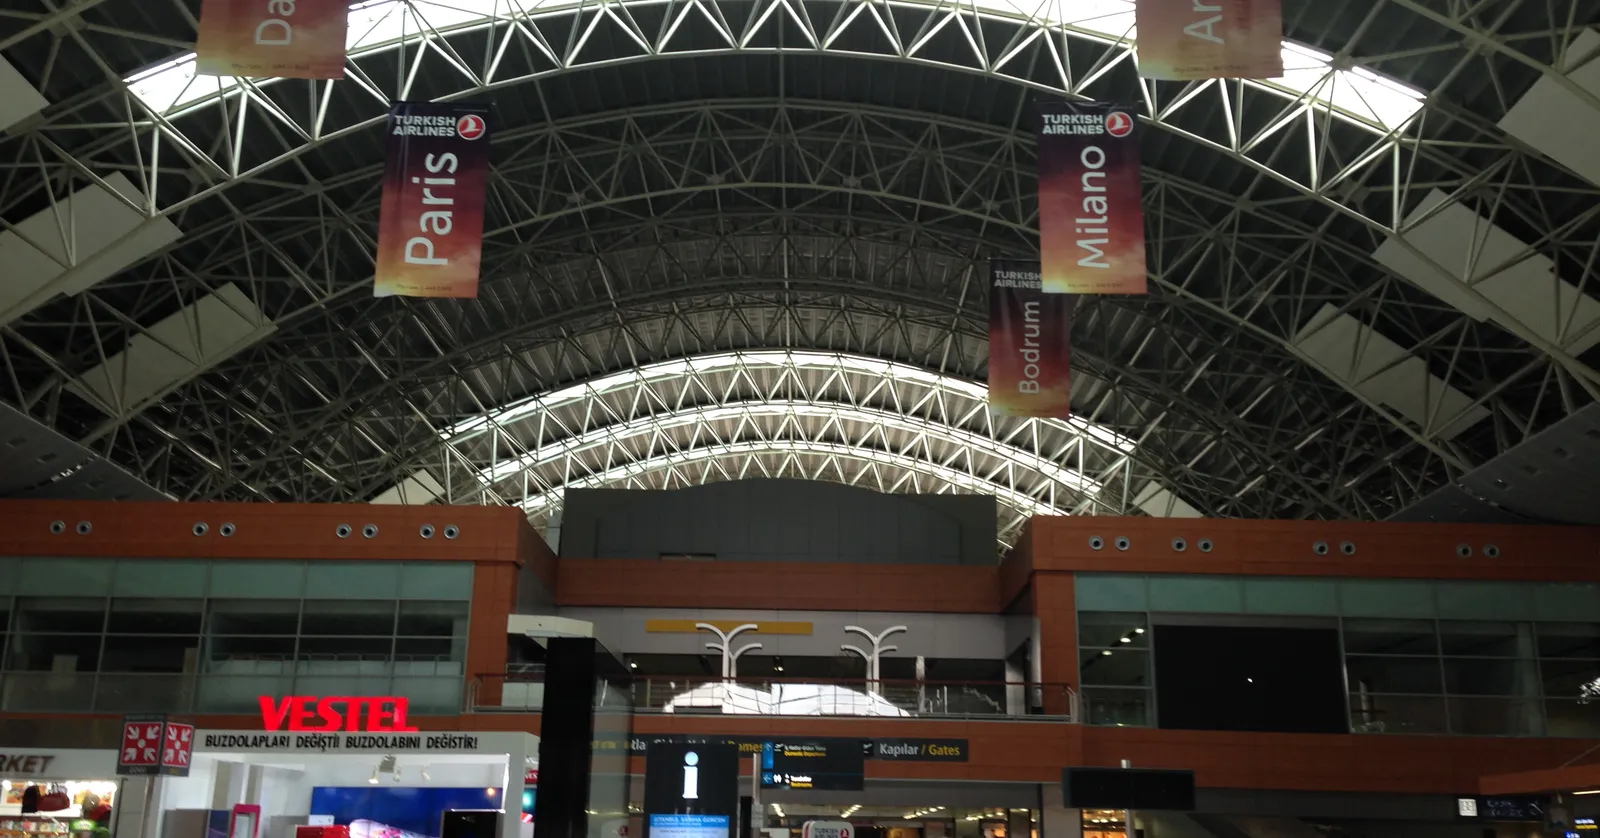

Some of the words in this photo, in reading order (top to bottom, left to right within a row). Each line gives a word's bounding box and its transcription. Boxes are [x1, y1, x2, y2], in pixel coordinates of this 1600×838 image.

[394, 115, 456, 126] TURKISH
[1042, 114, 1103, 124] TURKISH
[392, 125, 456, 137] AIRLINES
[1042, 124, 1104, 134] AIRLINES
[404, 152, 458, 265] Paris
[1075, 146, 1110, 268] Milano
[994, 270, 1042, 281] TURKISH
[994, 279, 1042, 289] AIRLINES
[1019, 301, 1040, 393] Bodrum
[258, 695, 419, 733] VESTEL
[205, 734, 290, 748] BUZDOLAPLARI
[345, 735, 420, 749] BUZDOLABINI
[879, 743, 919, 757] Kapılar
[928, 744, 961, 756] Gates
